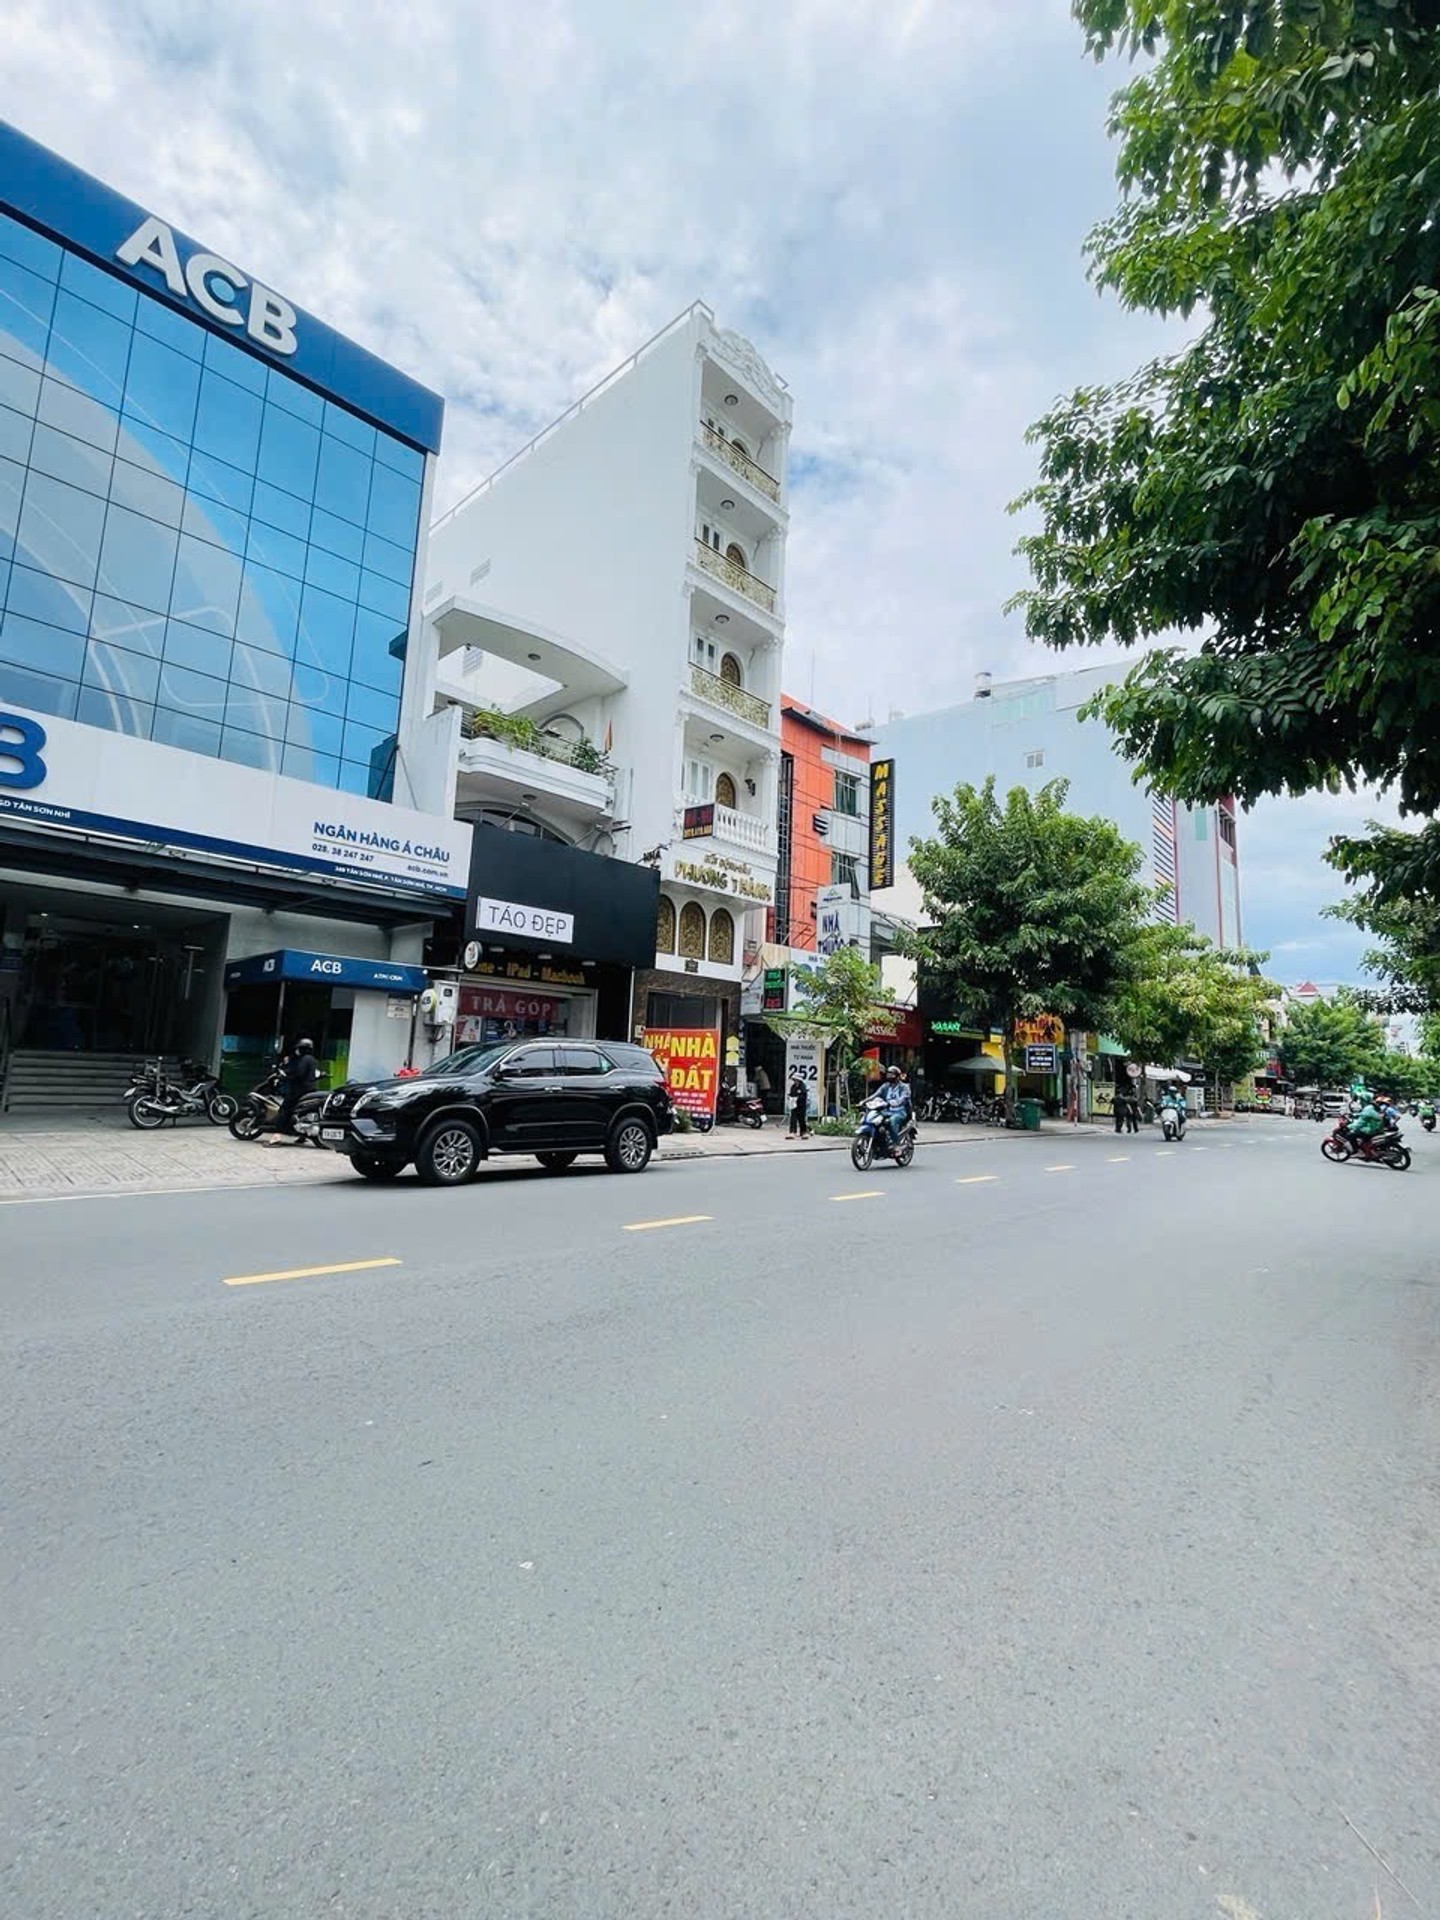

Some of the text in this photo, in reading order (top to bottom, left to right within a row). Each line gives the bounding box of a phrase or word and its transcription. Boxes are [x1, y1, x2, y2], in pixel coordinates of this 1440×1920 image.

[116, 216, 298, 356] ACB
[13, 801, 33, 812] TÂN
[33, 805, 54, 816] SƠN
[312, 843, 330, 853] 028.
[343, 850, 358, 859] 247
[360, 853, 374, 862] 247
[314, 822, 450, 862] NGÂN HÀNG Á CHÂU
[488, 905, 567, 937] TÁO ĐẸP
[311, 960, 342, 974] ACB
[471, 994, 551, 1017] TRẢ GÓP
[671, 1032, 716, 1058] NHÀ
[671, 1062, 714, 1090] ĐẤT
[789, 1064, 818, 1081] 252
